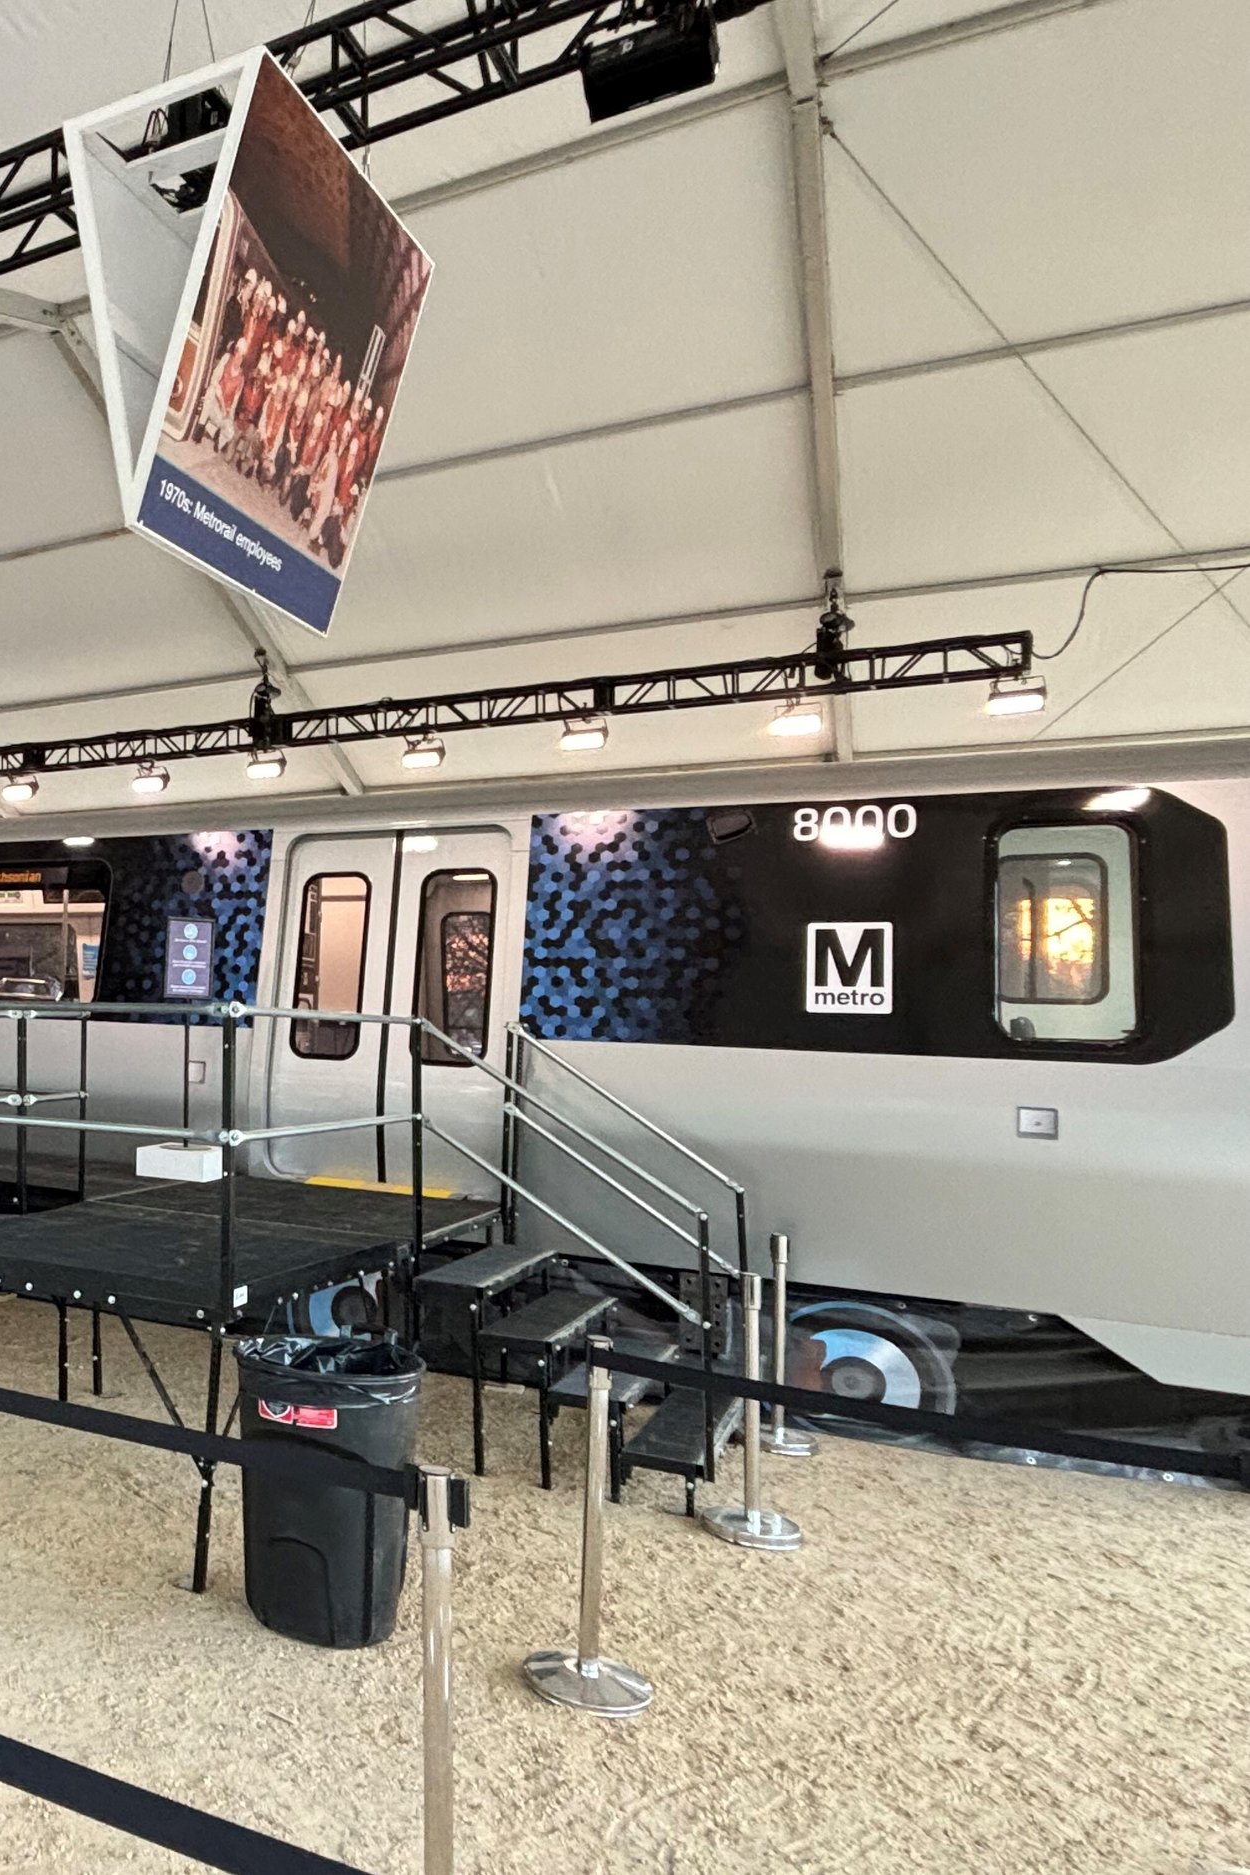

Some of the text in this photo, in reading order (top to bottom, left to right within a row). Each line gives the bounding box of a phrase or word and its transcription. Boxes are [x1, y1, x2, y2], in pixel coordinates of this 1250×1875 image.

[159, 479, 283, 572] 1970s: Metrorail employees
[793, 803, 918, 843] 8000
[814, 928, 886, 988] M
[814, 990, 886, 1006] metro
